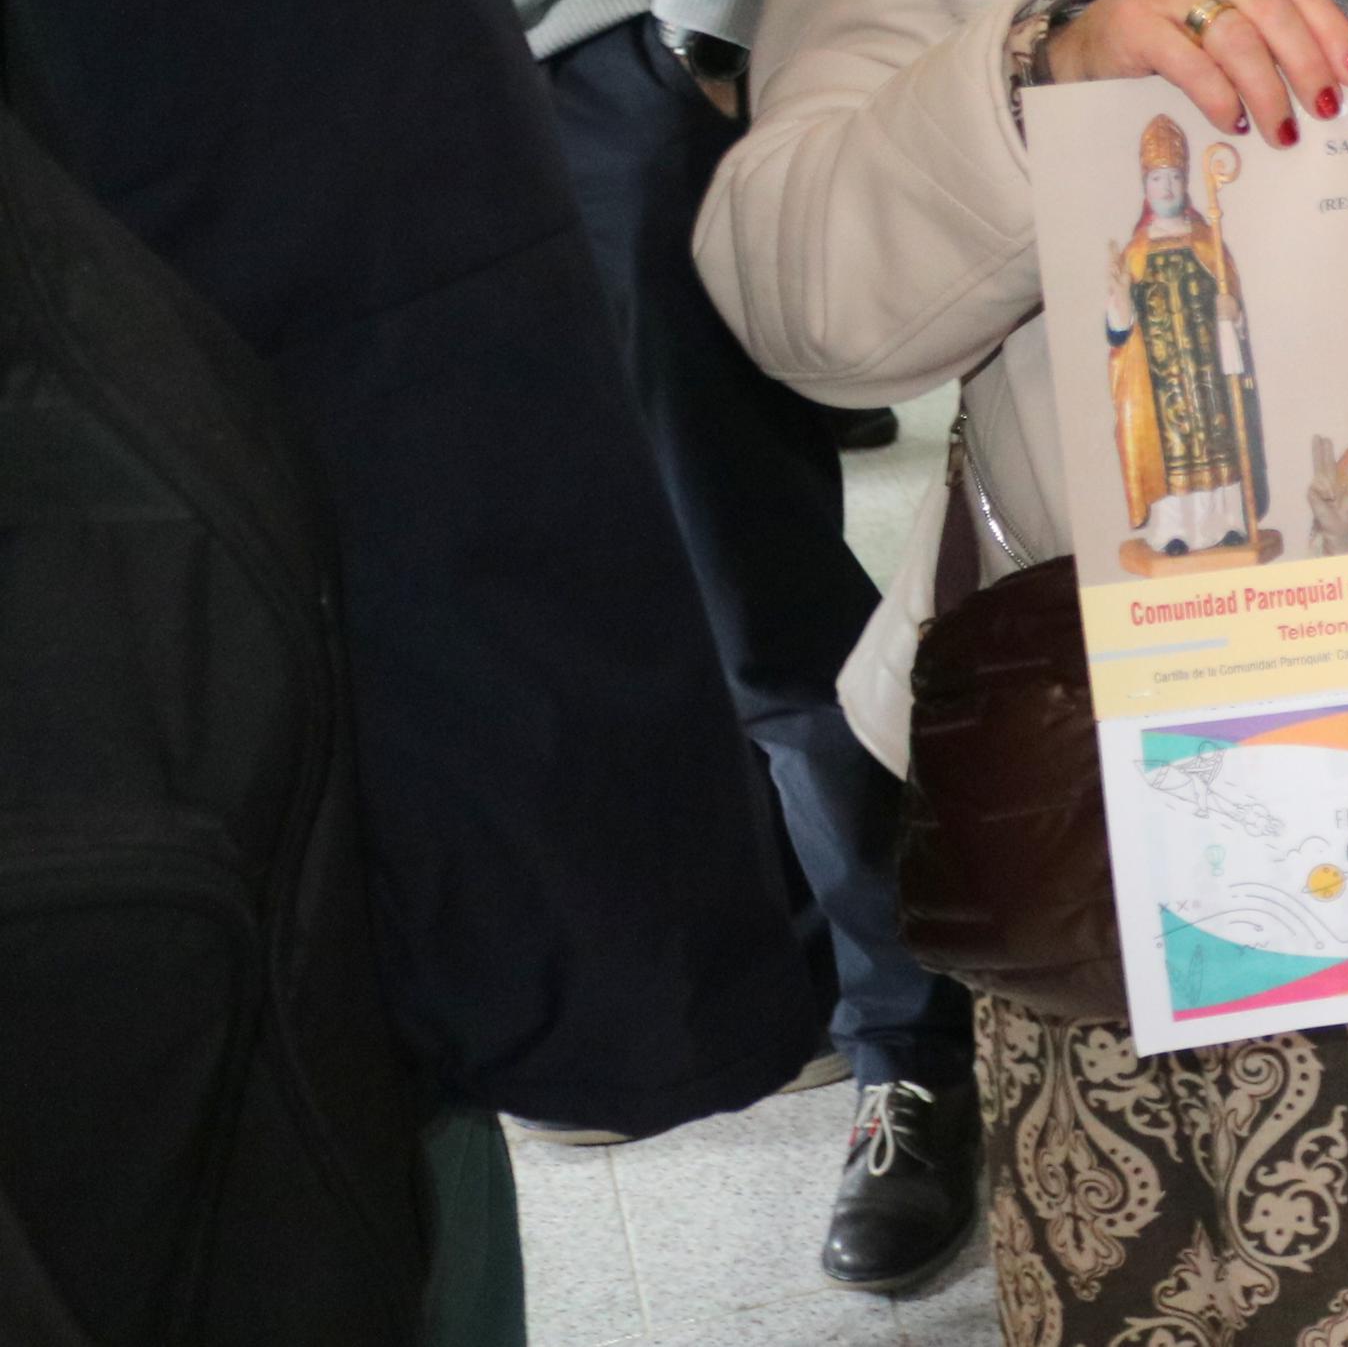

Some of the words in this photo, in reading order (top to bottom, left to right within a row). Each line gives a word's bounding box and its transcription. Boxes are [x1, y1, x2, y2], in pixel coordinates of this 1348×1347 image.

[1130, 591, 1238, 626] Comunidad
[1244, 577, 1344, 611] Parroquial
[1154, 668, 1190, 683] Cartilla
[1192, 666, 1205, 679] de
[1207, 666, 1217, 678] la
[1219, 658, 1277, 677] Comunidad
